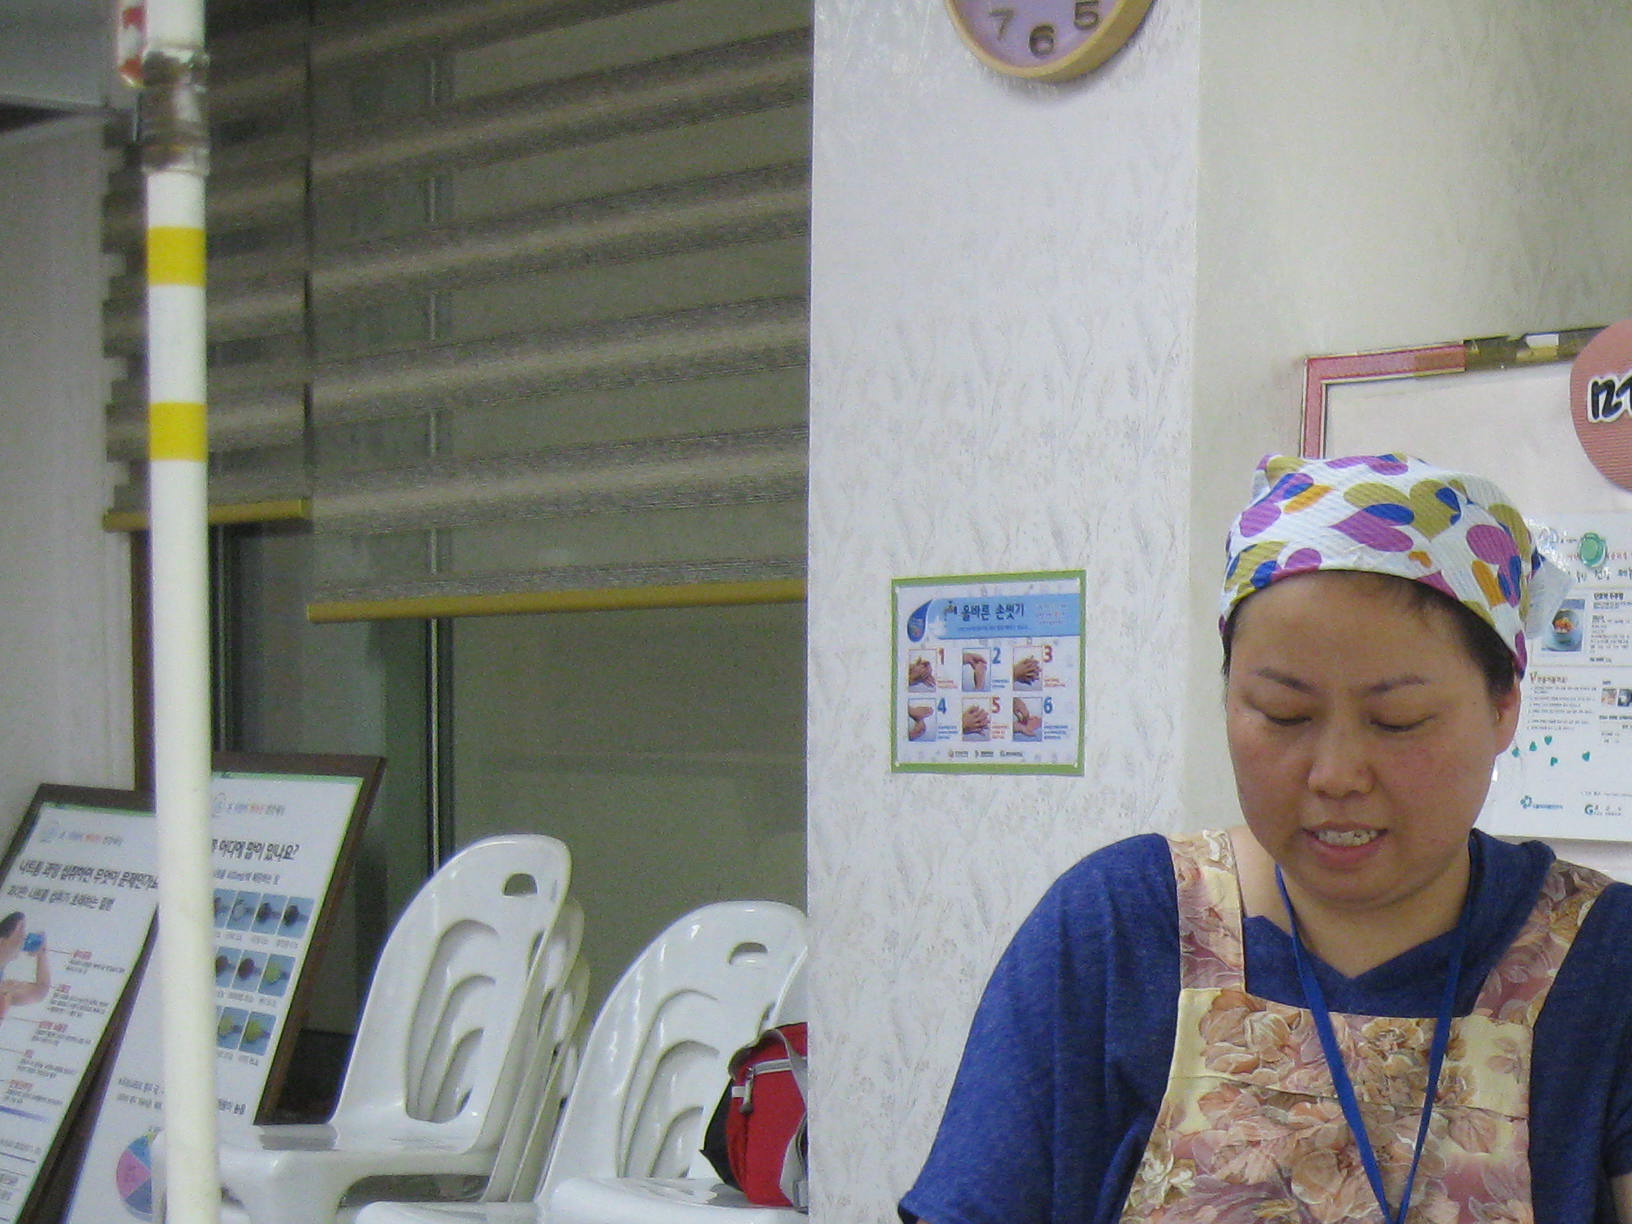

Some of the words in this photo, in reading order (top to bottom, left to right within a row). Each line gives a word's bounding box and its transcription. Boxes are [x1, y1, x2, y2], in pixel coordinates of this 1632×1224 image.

[989, 8, 1014, 40] 7
[1073, 1, 1099, 30] 5
[1029, 24, 1055, 58] 6
[962, 604, 989, 621] 올바른
[996, 602, 1024, 620] 손씻기
[938, 648, 945, 665] 1
[992, 647, 1001, 664] 2
[1043, 645, 1053, 662] 3
[937, 697, 947, 714] 4
[991, 696, 1001, 713] 5
[1044, 697, 1053, 714] 6
[264, 842, 300, 862] 있나요?
